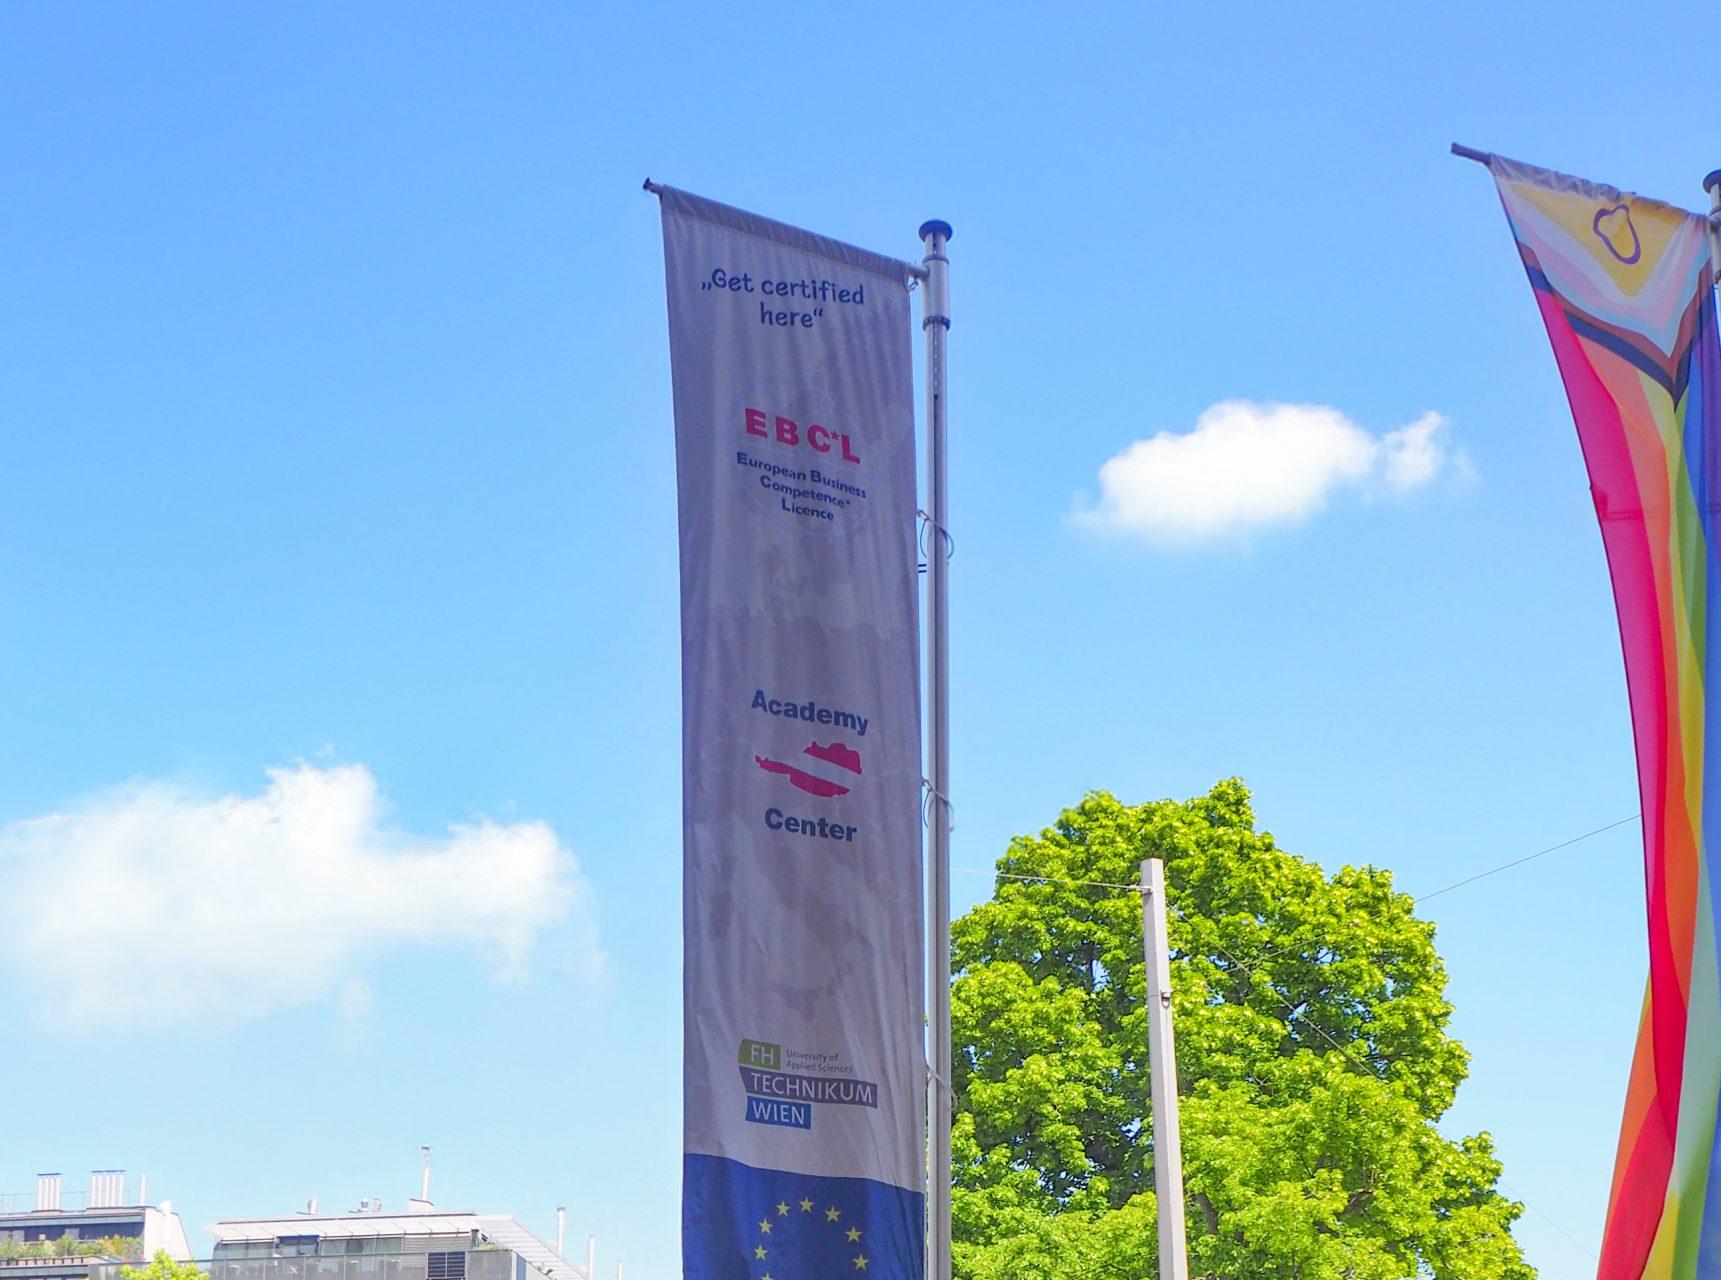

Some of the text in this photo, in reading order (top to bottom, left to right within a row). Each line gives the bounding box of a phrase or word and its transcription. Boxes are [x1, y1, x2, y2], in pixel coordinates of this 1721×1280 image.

[761, 280, 864, 305] certified
[760, 302, 823, 328] here“
[736, 452, 867, 498] European Business
[781, 498, 835, 521] Licence
[751, 689, 869, 736] Academy
[764, 807, 858, 842] Center
[751, 1044, 774, 1065] FH
[786, 1050, 839, 1063] University of
[786, 1060, 853, 1073] Applied Sciences
[751, 1072, 873, 1104] TECHNIKUM
[752, 1101, 805, 1125] WIEN
